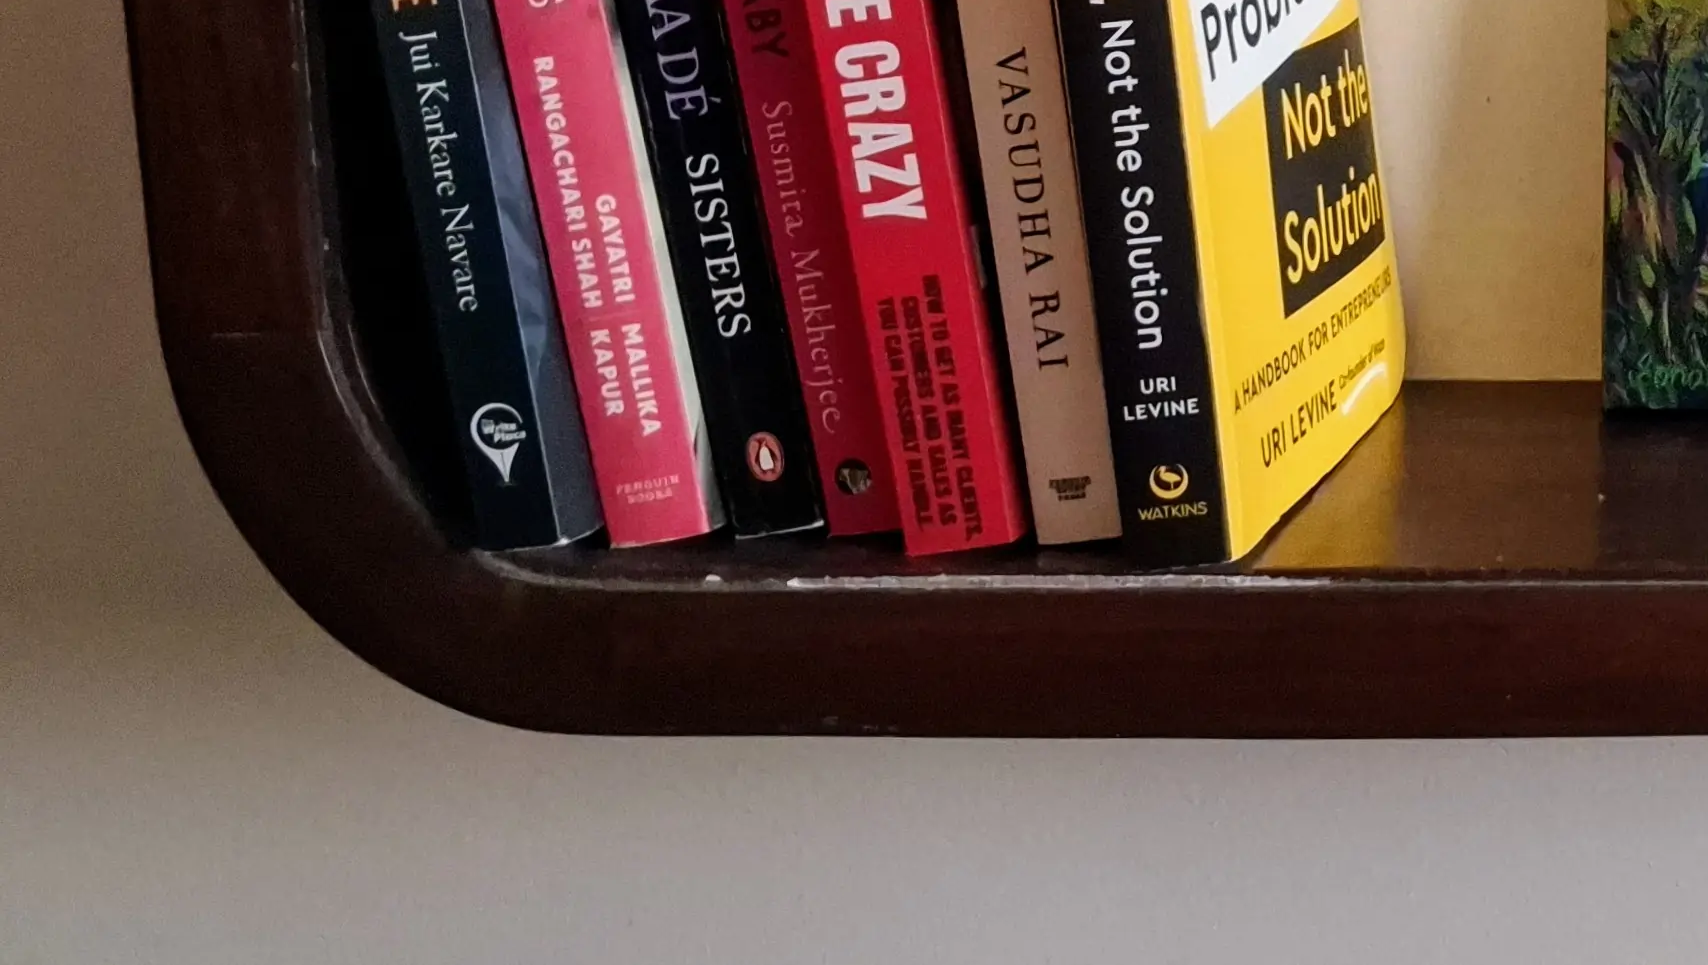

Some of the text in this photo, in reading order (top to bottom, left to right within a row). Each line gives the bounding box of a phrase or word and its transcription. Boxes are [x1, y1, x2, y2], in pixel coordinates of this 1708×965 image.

[658, 47, 721, 120] DÉ
[1099, 20, 1139, 94] Not
[834, 41, 927, 222] CRAZY
[1111, 105, 1150, 172] the
[1280, 48, 1368, 161] Not the
[399, 31, 479, 313] Jui Karkare Navare
[533, 56, 602, 308] RANGACHARI SHAH
[996, 47, 1069, 371] VASUDHA RAI
[595, 194, 635, 304] GAYATRI
[685, 153, 752, 338] SISTERS
[762, 101, 838, 435] Susmita Mukherjee
[1121, 186, 1168, 350] Solution
[1284, 166, 1382, 284] Solution
[877, 296, 898, 330] YOU
[922, 274, 944, 314] HOW
[930, 319, 949, 341] TO
[589, 329, 625, 417] KAPUR
[621, 323, 662, 436] MALLIKA
[884, 335, 905, 372] CAN
[934, 345, 956, 376] GET
[1235, 265, 1391, 414] A HANDBOOK FOR ENTREPRENEURS
[940, 383, 961, 406] AS
[1123, 397, 1200, 422] LEVINE
[1140, 376, 1177, 395] URI
[1261, 421, 1286, 467] URI
[1291, 379, 1337, 445] LEVINE
[938, 502, 957, 526] AS
[1138, 501, 1208, 521] WATKINS
